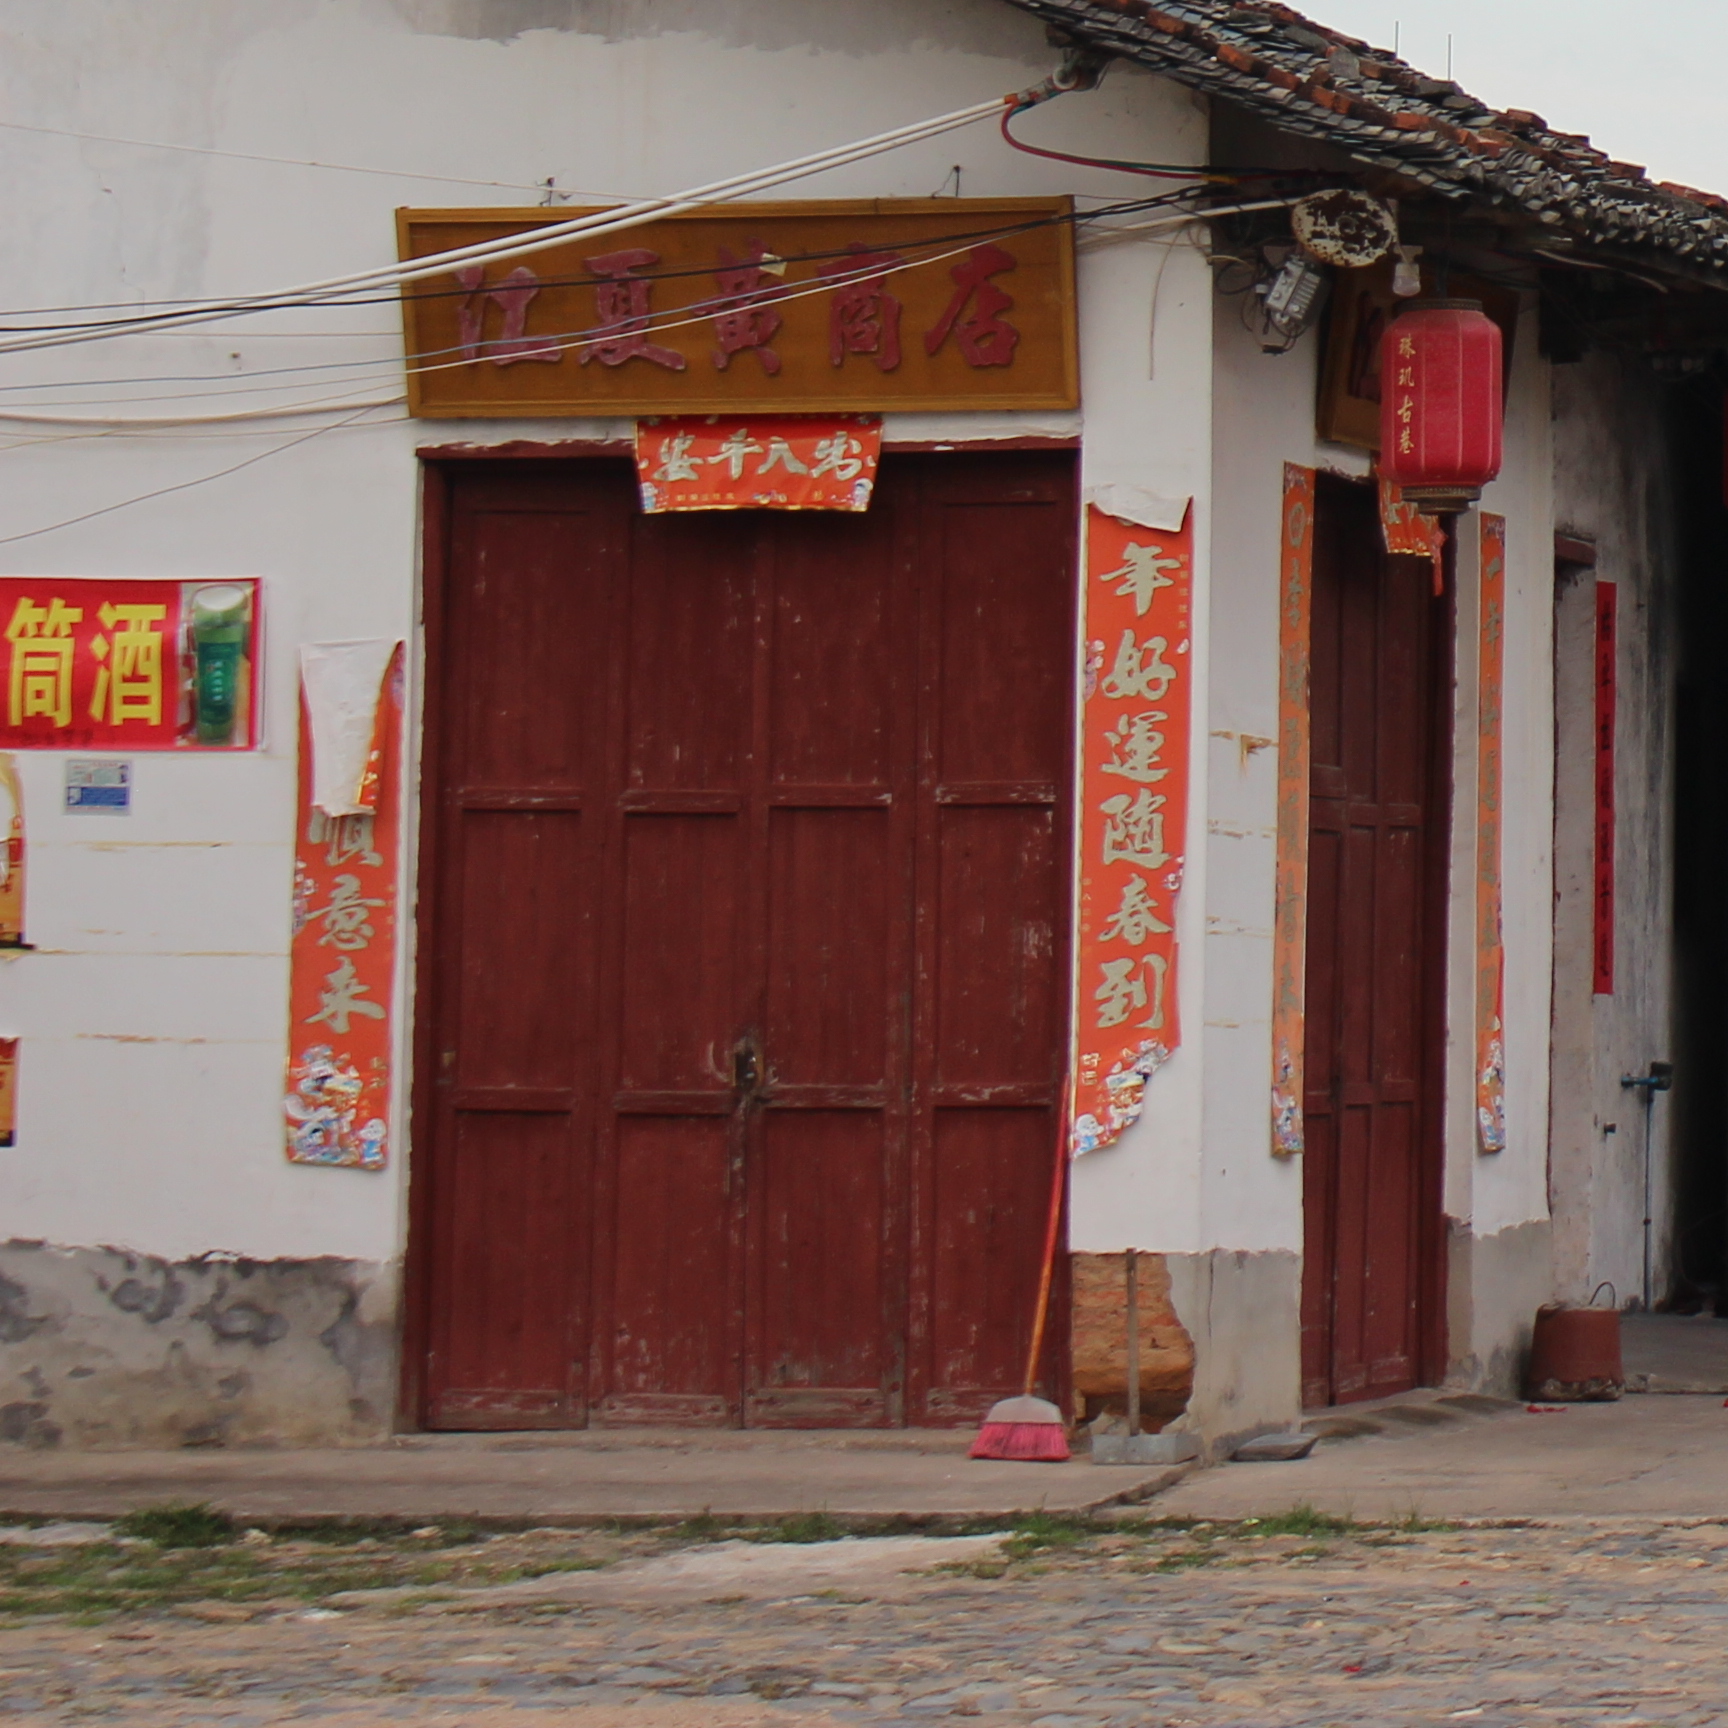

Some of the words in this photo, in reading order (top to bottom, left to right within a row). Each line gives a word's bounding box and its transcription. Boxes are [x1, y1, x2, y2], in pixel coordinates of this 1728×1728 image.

[1397, 333, 1416, 454] 珠玑古巷
[3, 595, 167, 728] 筒酒
